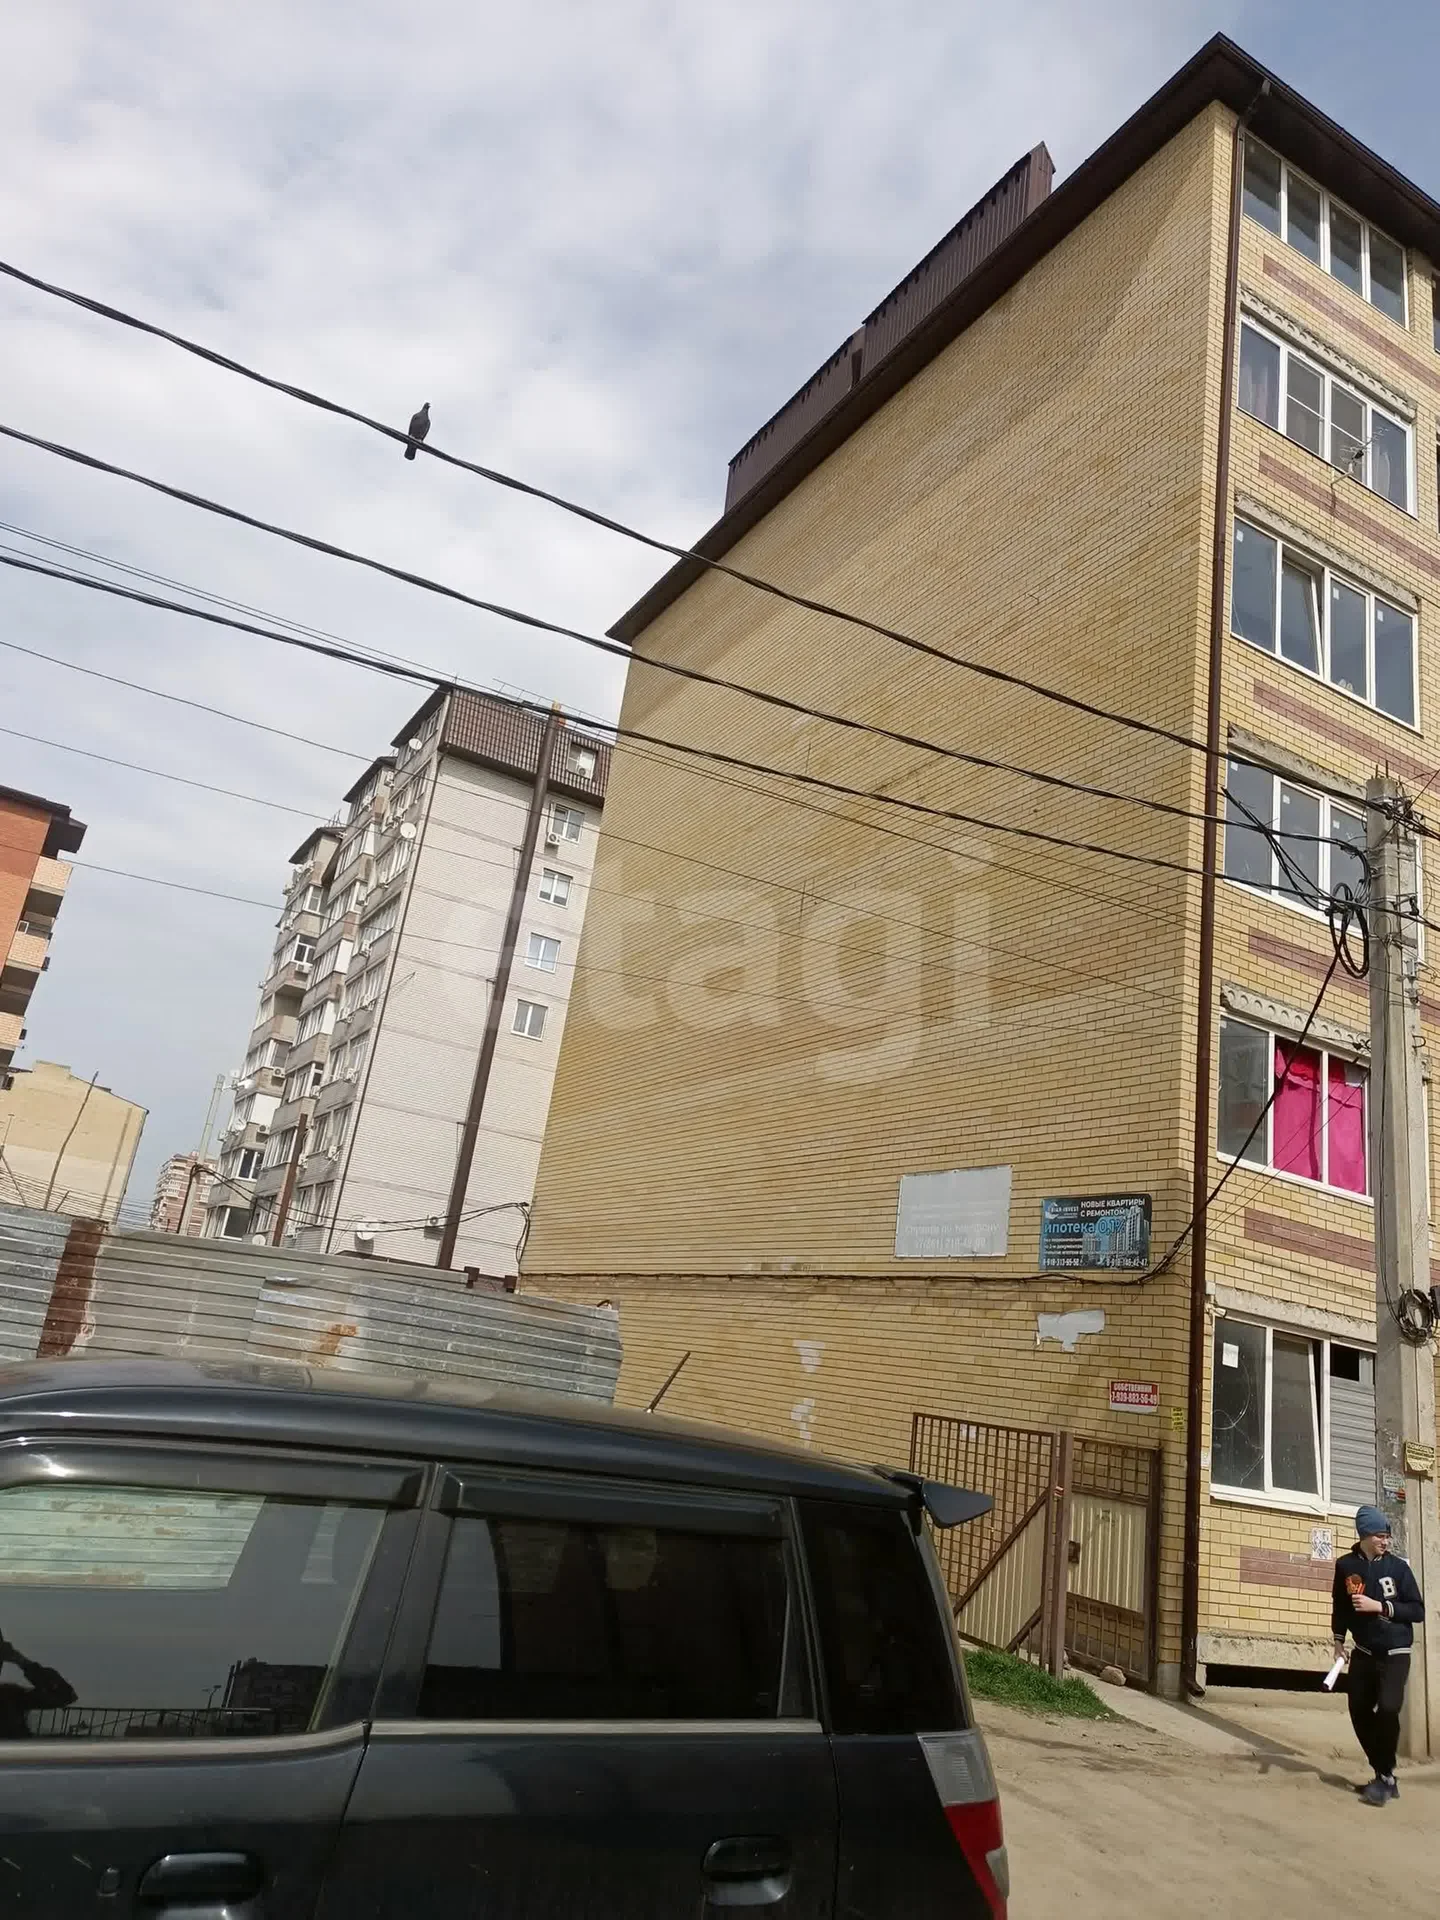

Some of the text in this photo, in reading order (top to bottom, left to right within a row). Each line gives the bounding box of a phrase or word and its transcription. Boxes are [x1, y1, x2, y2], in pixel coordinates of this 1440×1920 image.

[1080, 1198, 1145, 1209] НОВЫЕ КВАРТИРЫ
[1080, 1209, 1086, 1217] С
[1086, 1207, 1126, 1217] РЕМОНТОМ
[1044, 1218, 1127, 1235] ипотека 0,1%
[1113, 1382, 1153, 1394] СОБСТВЕННИК
[1379, 1576, 1396, 1599] B
